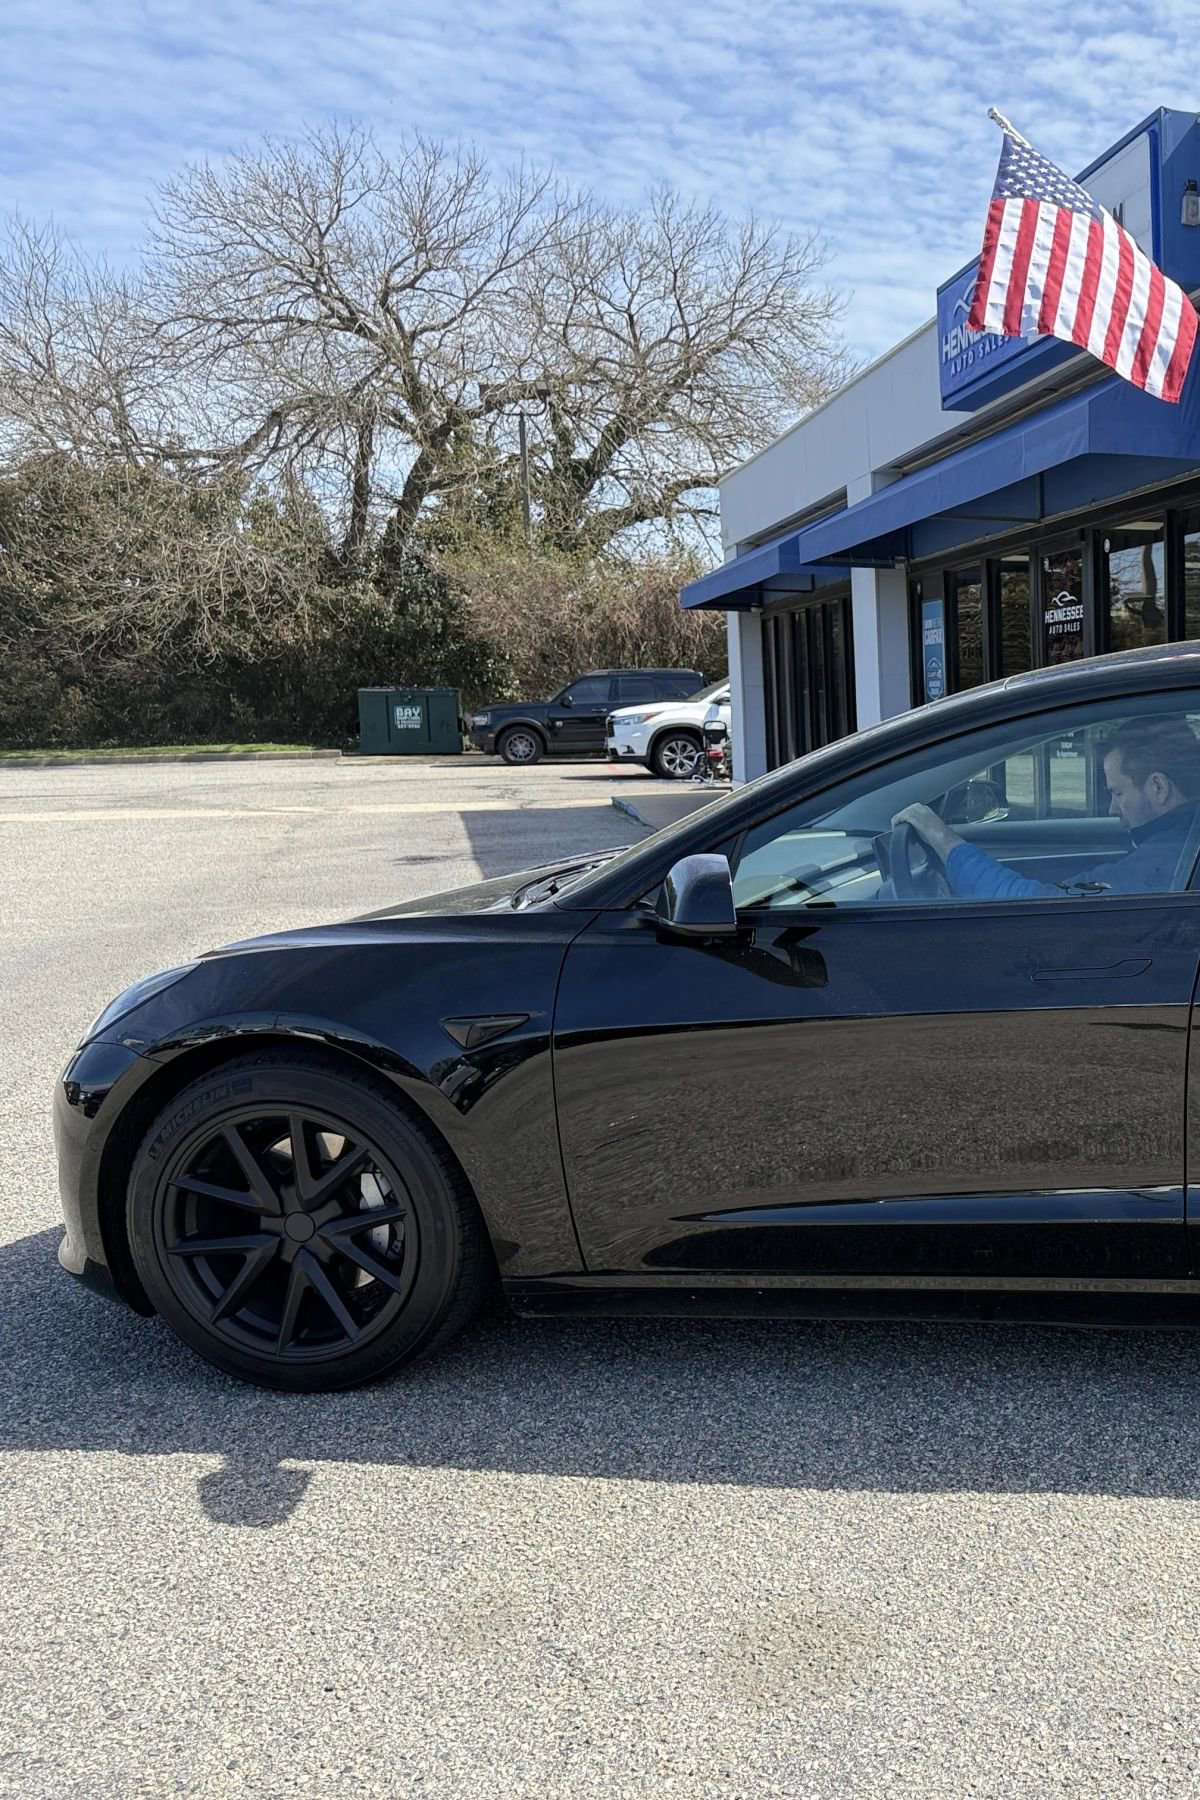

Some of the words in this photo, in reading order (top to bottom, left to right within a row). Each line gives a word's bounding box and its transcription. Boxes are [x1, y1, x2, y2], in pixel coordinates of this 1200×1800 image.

[950, 350, 974, 377] AUTO
[1044, 604, 1084, 624] HENNESSEE
[1048, 624, 1063, 635] AUTO
[1064, 621, 1080, 633] SALES
[396, 707, 420, 716] BAY
[160, 1084, 228, 1141] MICHELIN
